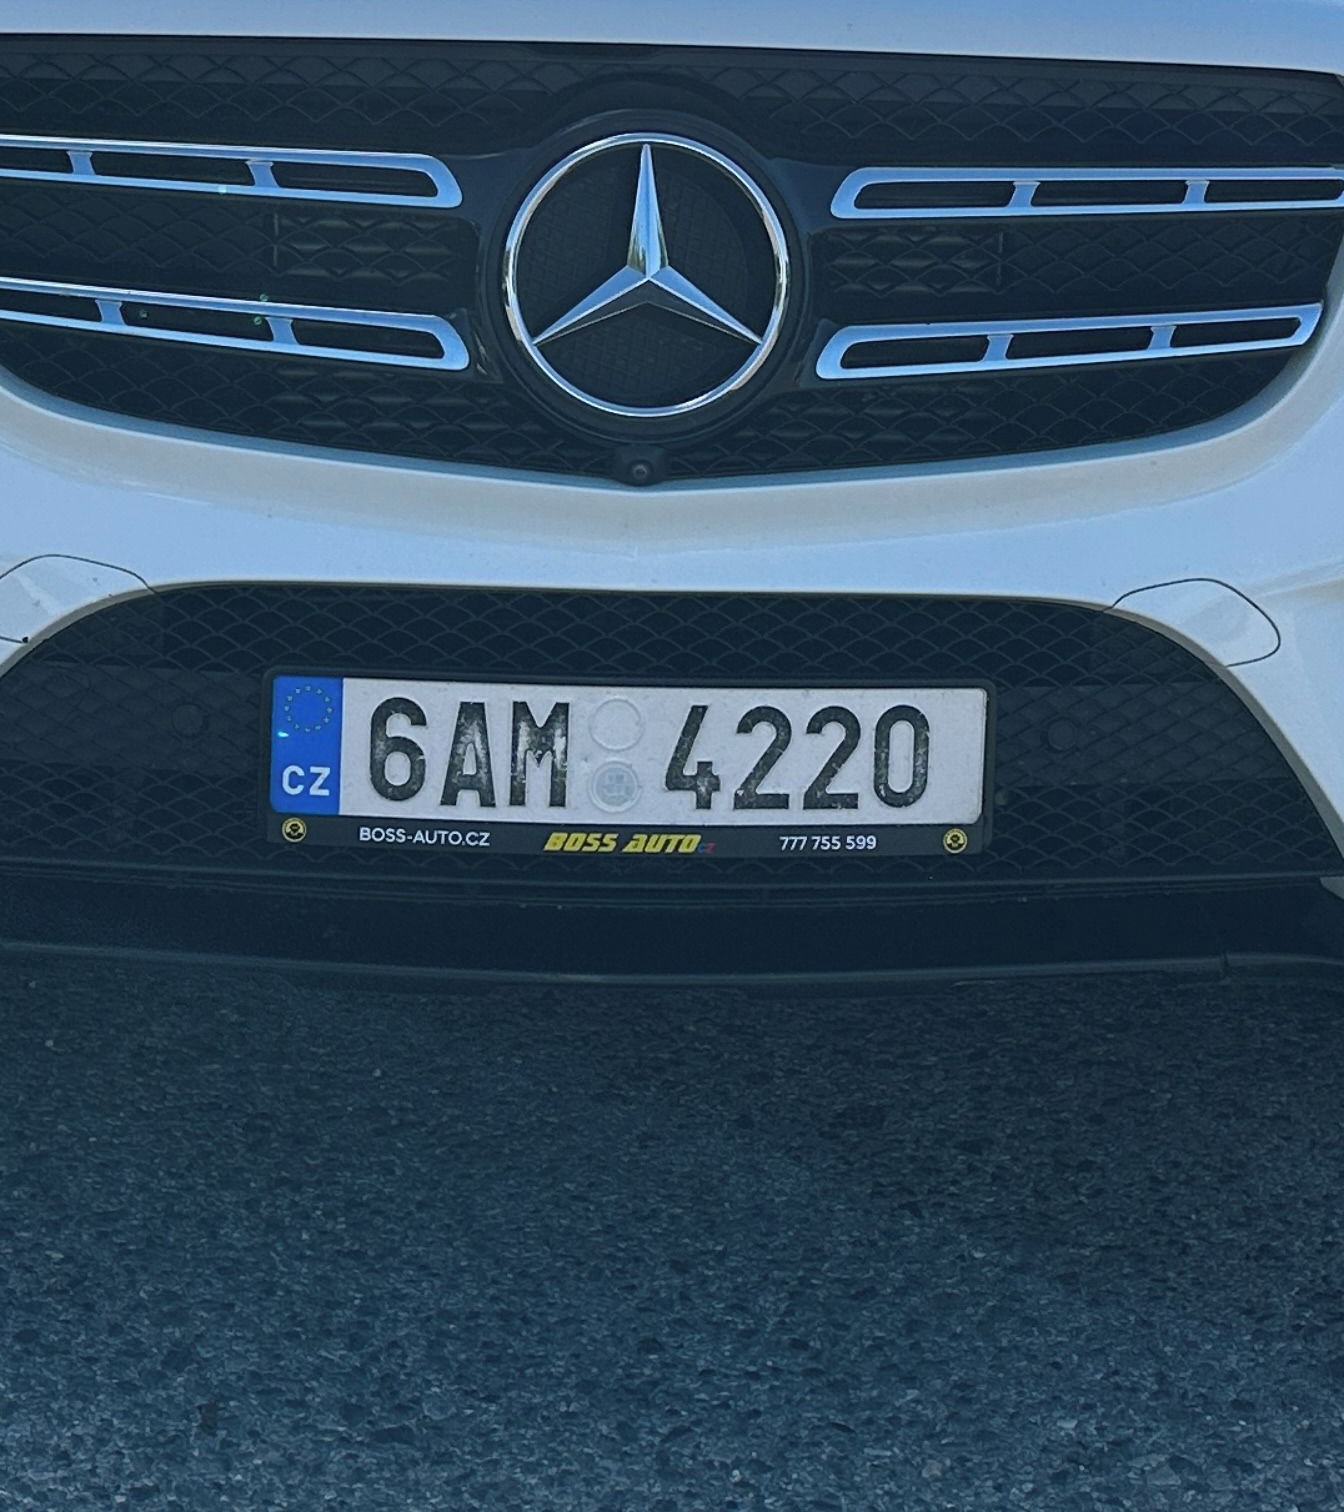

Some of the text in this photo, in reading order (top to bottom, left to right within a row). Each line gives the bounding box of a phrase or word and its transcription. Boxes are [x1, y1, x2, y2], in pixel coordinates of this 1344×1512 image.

[281, 696, 931, 811] CZ 6AM 4220
[359, 826, 491, 847] BOSS-AUTO.CZ
[544, 832, 619, 852] BOSS
[622, 834, 702, 854] AUTO
[779, 835, 808, 852] 777
[811, 836, 840, 852] 755
[845, 835, 877, 852] 599
